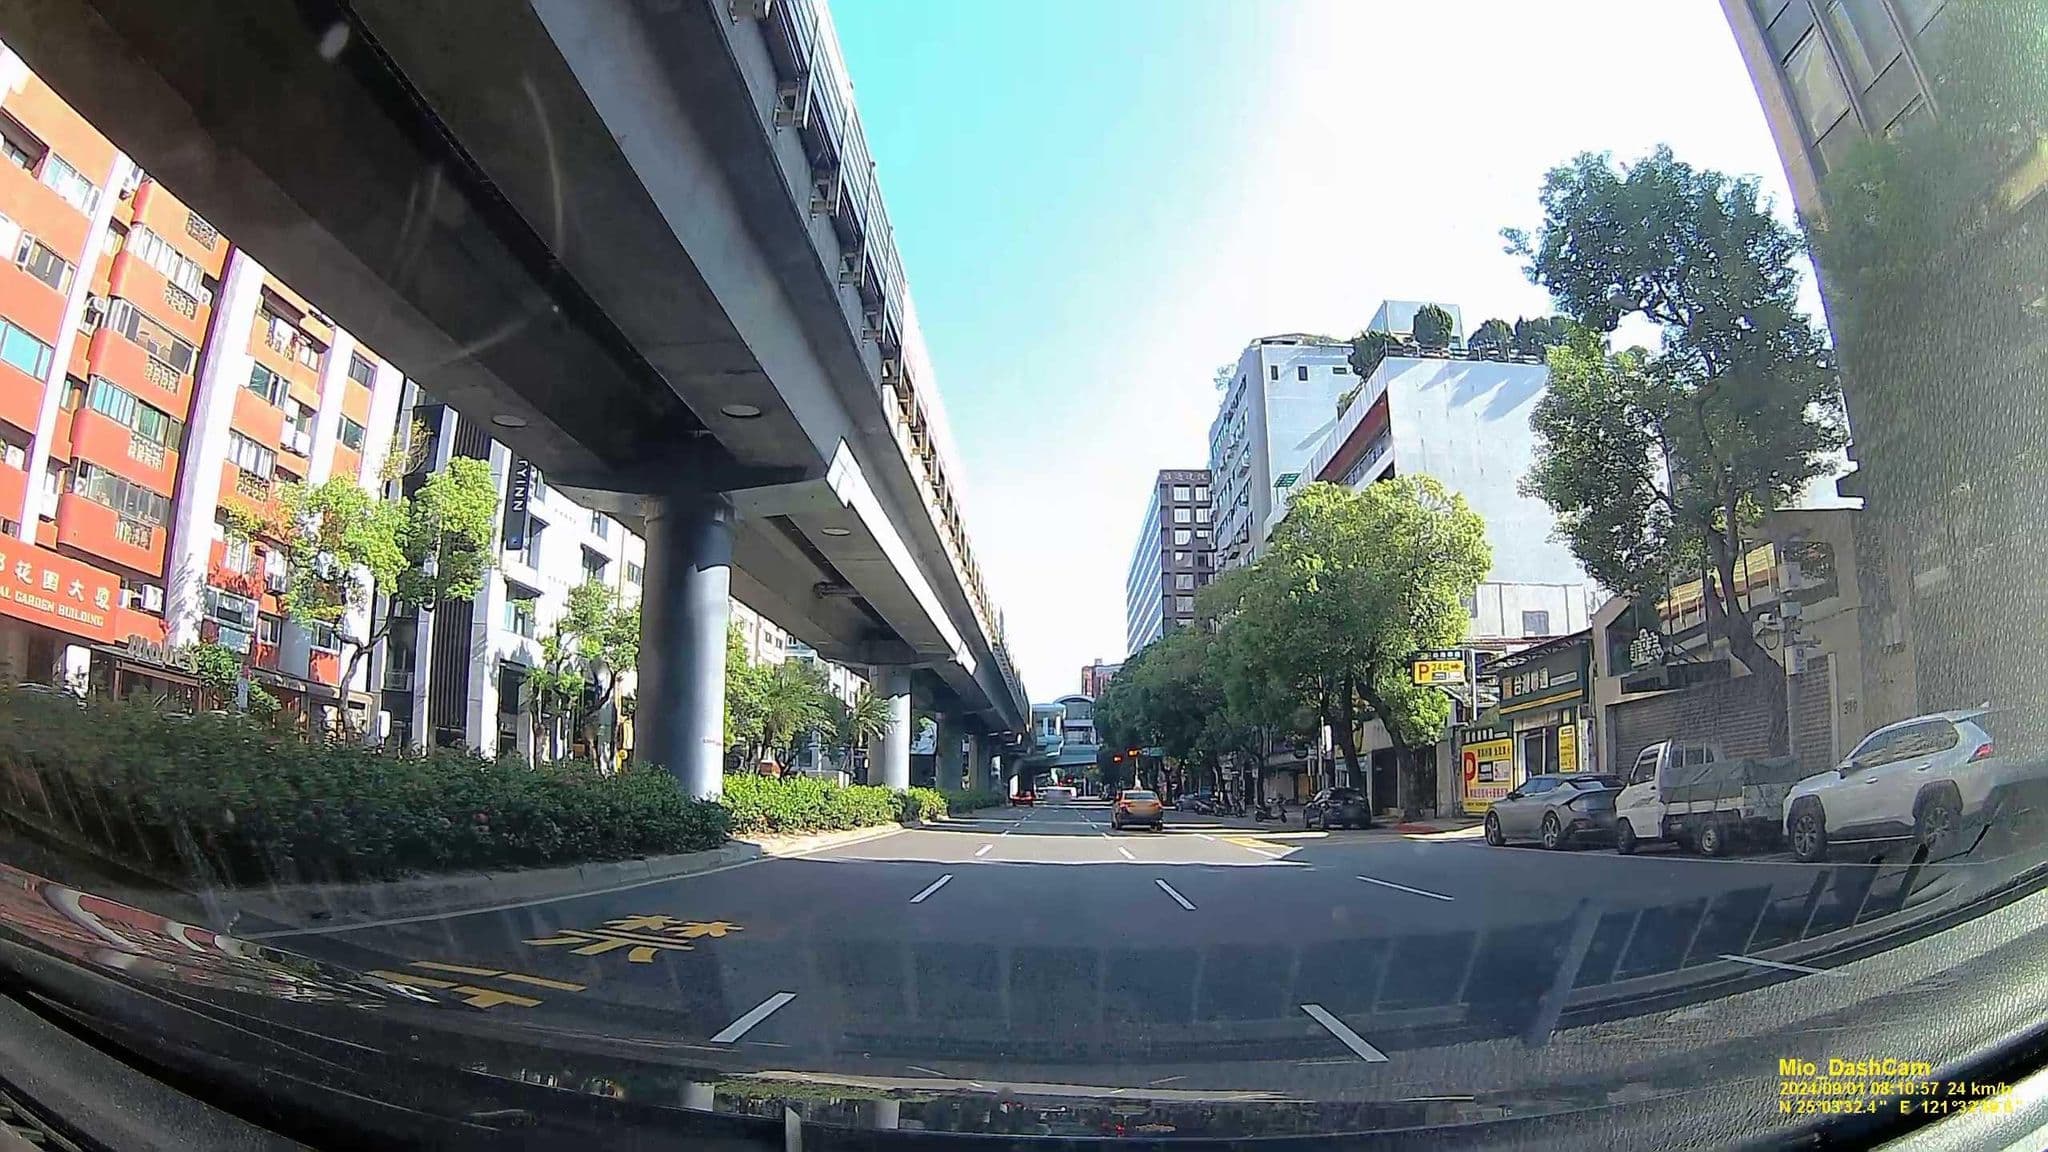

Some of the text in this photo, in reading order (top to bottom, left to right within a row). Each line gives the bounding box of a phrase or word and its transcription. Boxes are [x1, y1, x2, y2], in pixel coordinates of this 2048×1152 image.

[14, 590, 55, 613] GARDEN
[57, 604, 104, 627] BUILDING
[1419, 664, 1429, 681] P
